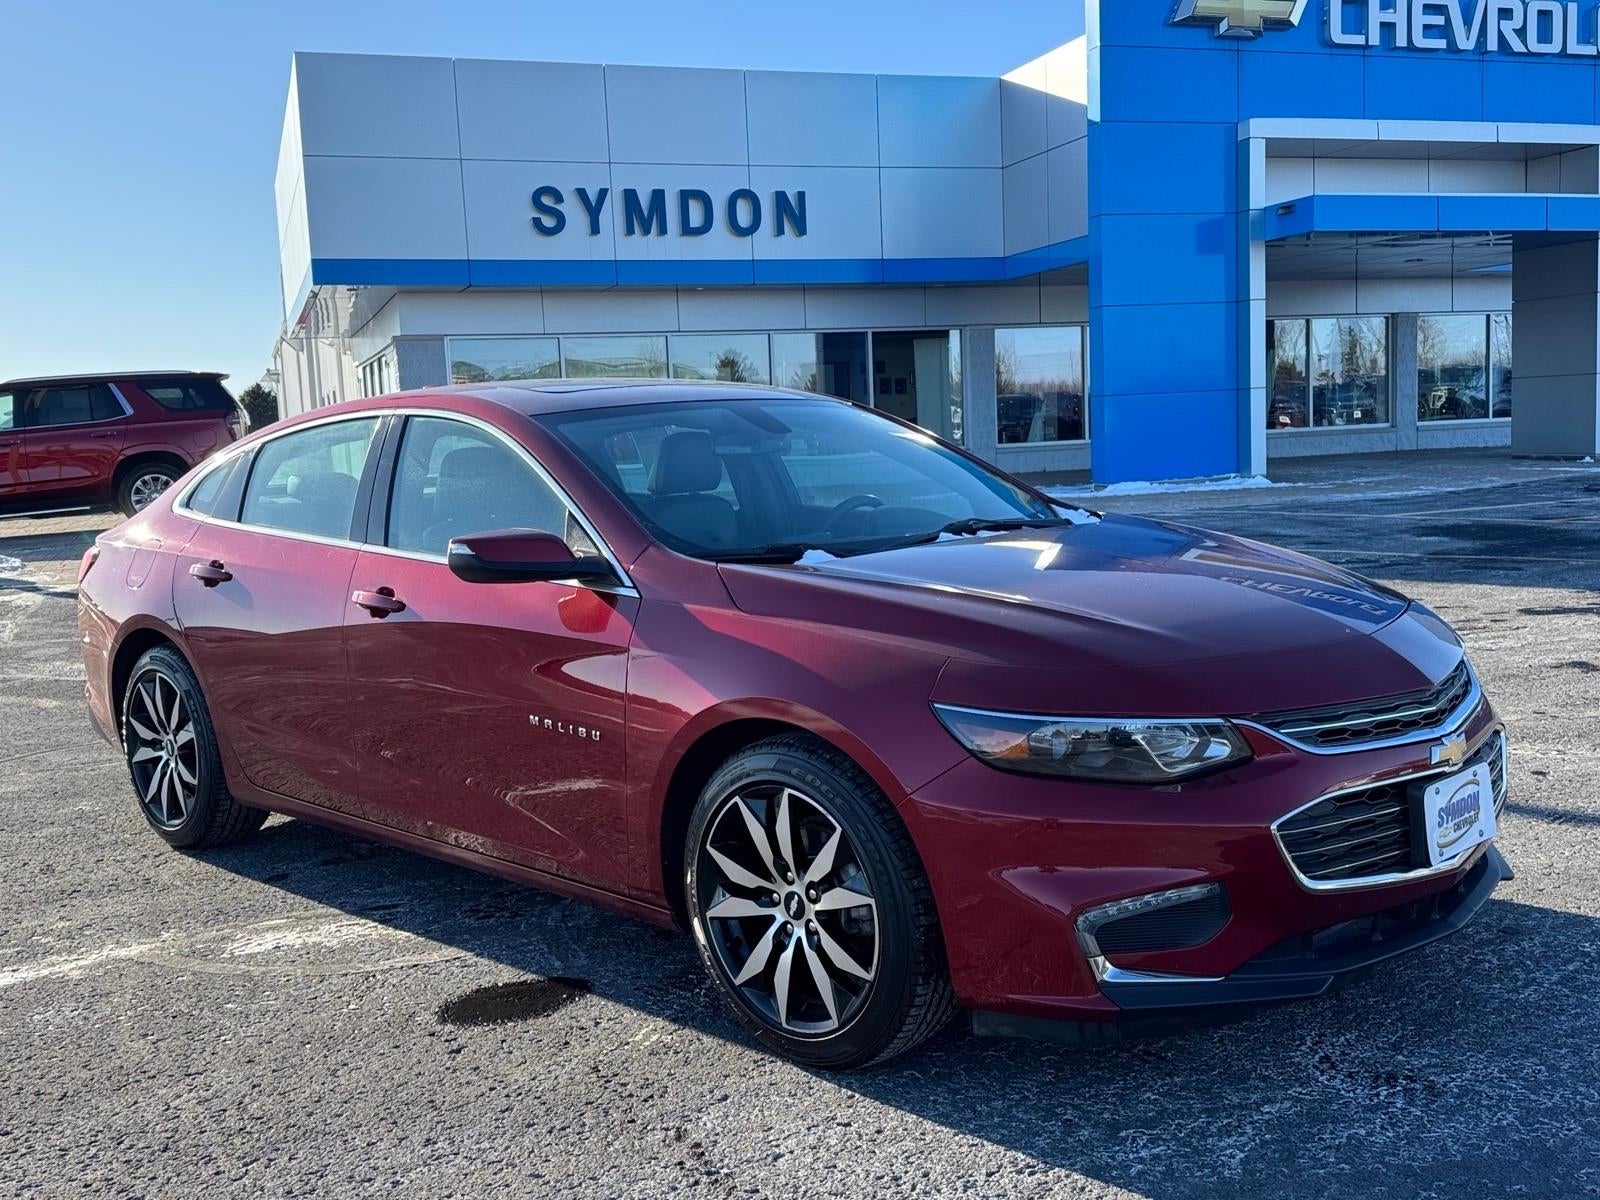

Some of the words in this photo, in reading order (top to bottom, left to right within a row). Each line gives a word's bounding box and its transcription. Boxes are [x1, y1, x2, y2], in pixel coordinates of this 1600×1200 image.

[1329, 0, 1600, 55] CHEVROL
[530, 185, 808, 238] SYMDON
[529, 714, 600, 741] MALIBU
[1437, 790, 1480, 829] SYMDON
